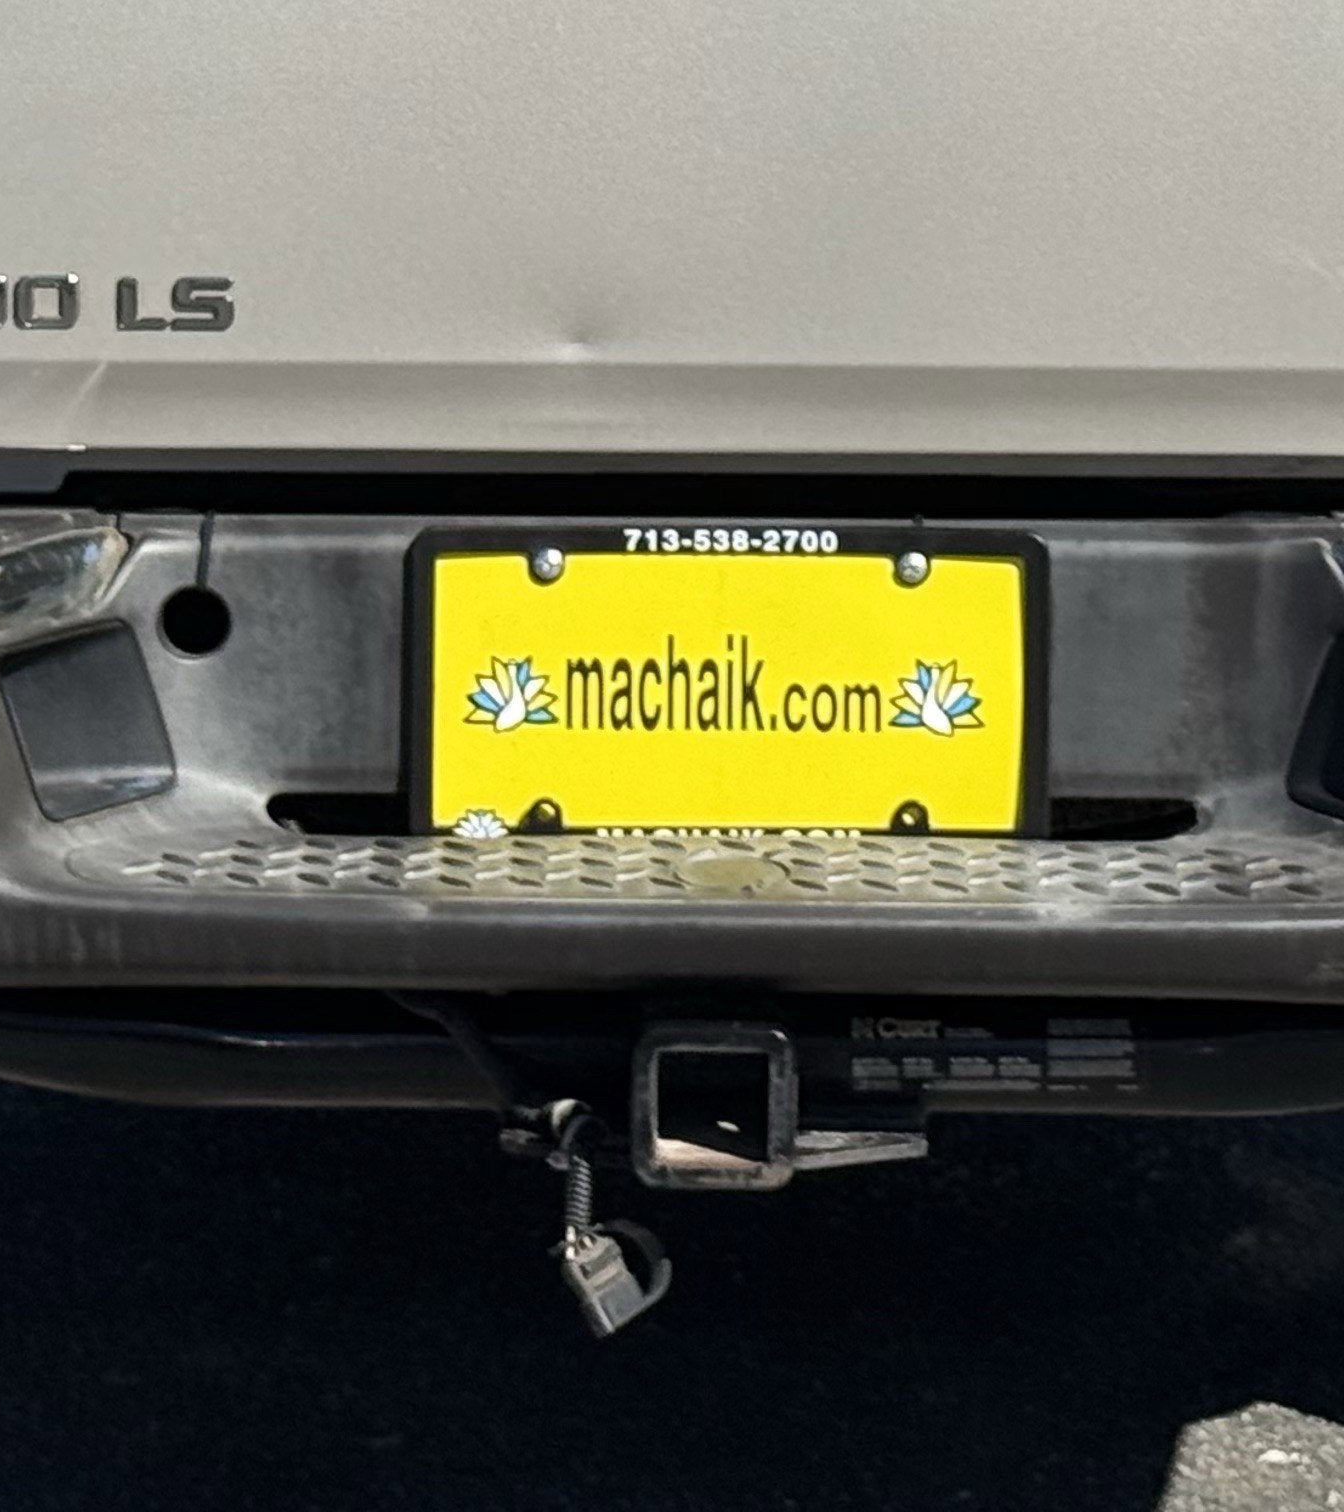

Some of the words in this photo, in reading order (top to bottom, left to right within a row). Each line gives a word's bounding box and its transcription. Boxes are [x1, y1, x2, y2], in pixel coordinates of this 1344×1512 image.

[115, 276, 236, 332] LS
[623, 528, 839, 553] 713-538-2700
[566, 634, 882, 732] machaik.com
